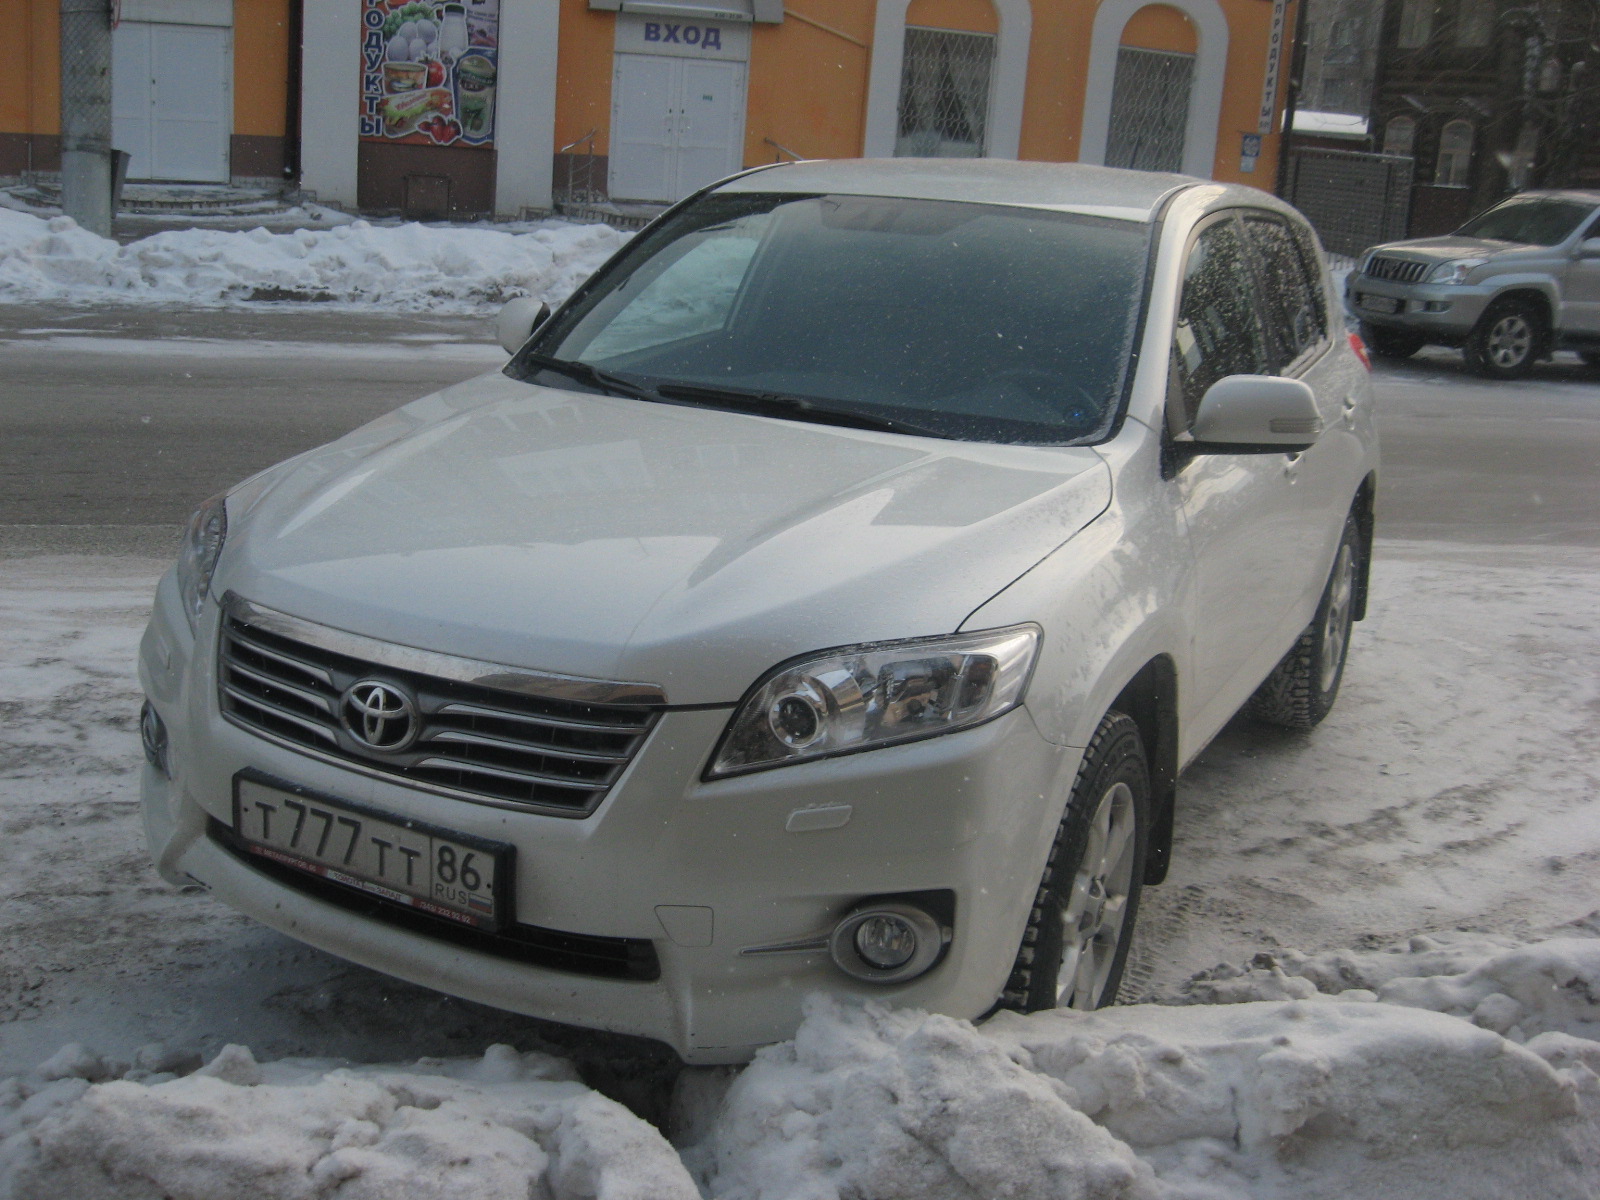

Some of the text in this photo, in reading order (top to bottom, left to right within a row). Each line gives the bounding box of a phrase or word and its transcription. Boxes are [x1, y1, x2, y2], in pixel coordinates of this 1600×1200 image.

[644, 22, 722, 50] ВХОД
[1261, 4, 1282, 117] ПРОДУКТЫ
[437, 845, 481, 891] 86
[434, 883, 468, 905] RUS
